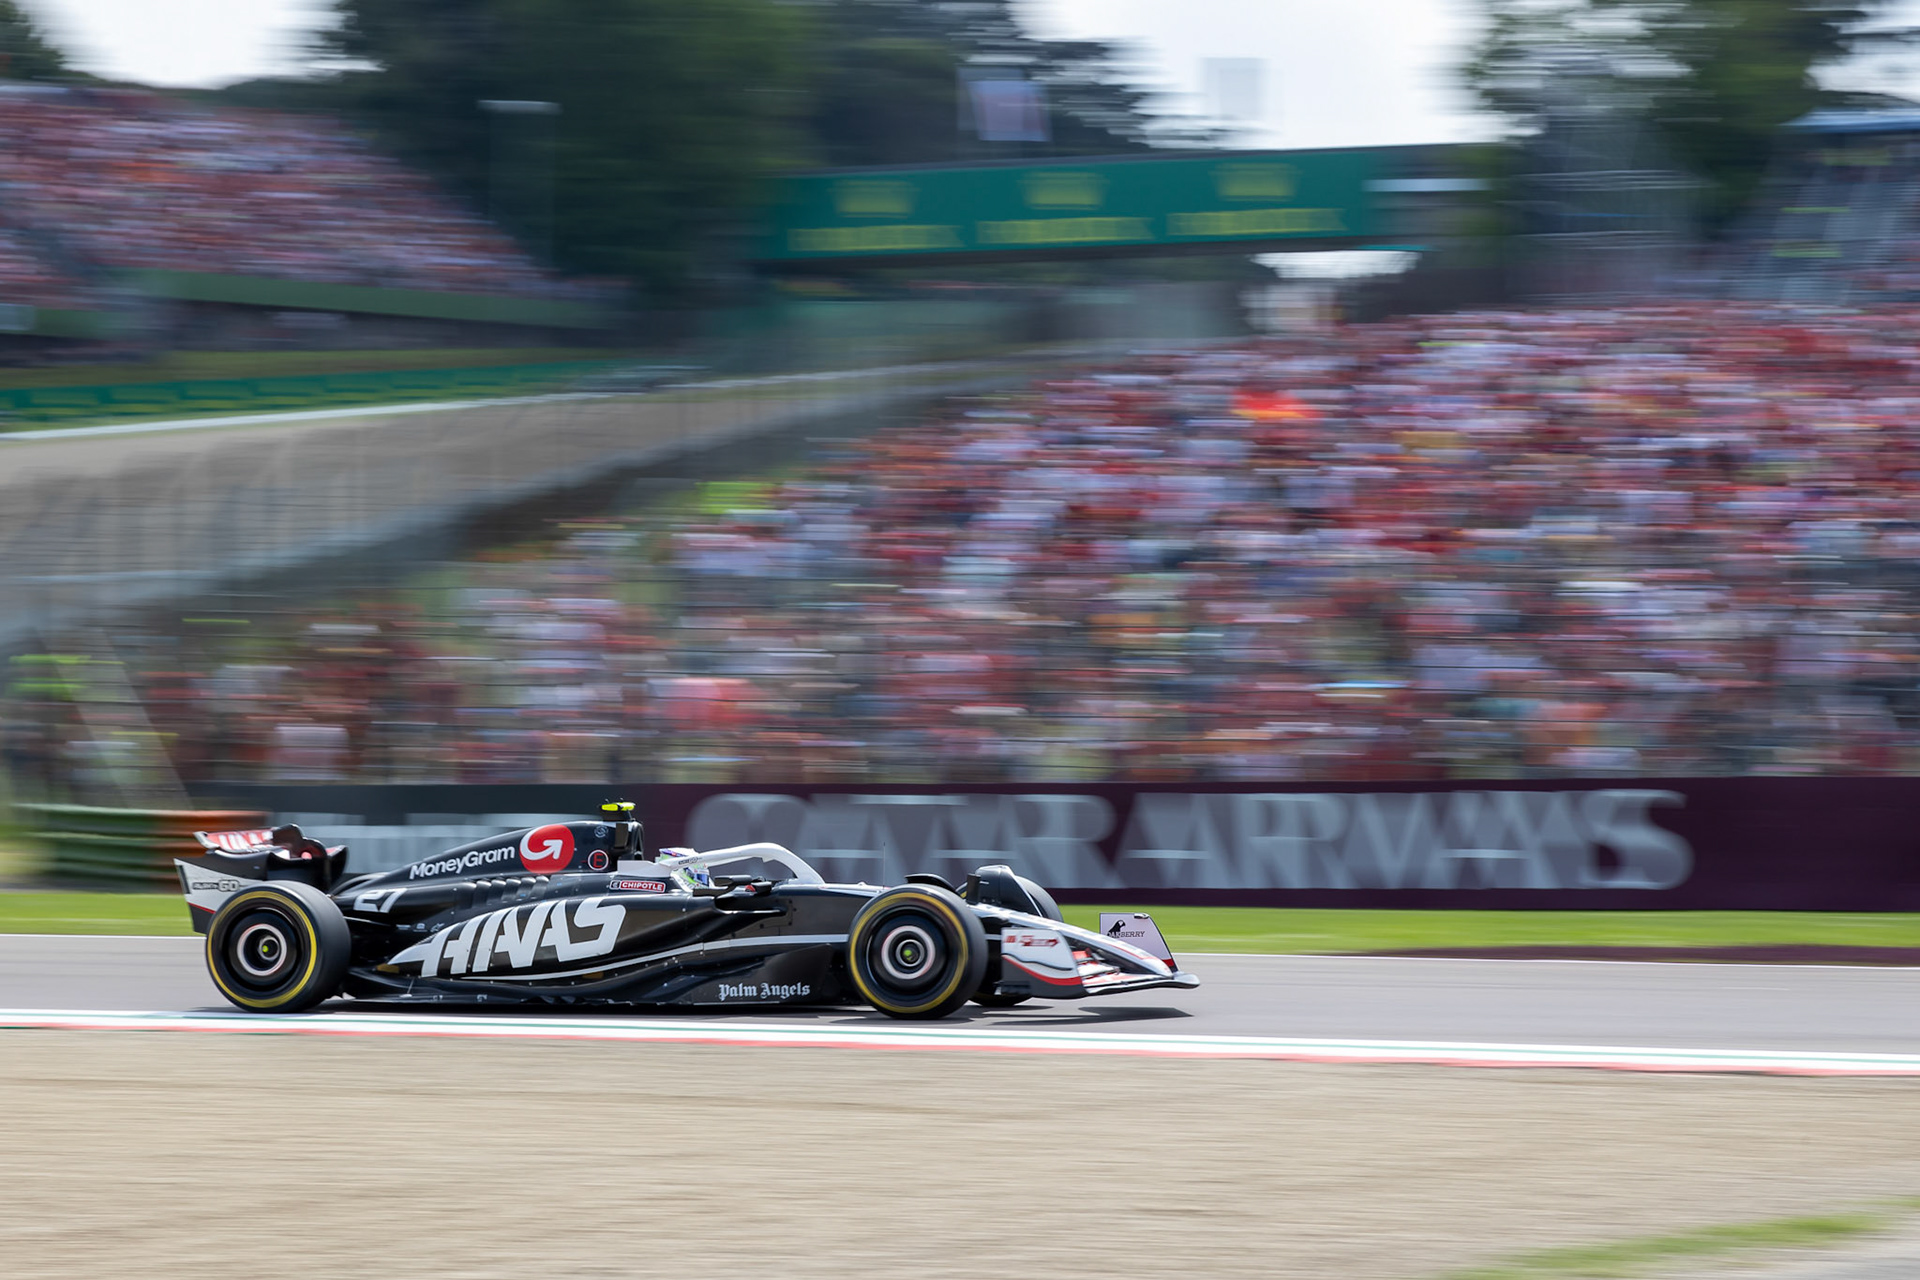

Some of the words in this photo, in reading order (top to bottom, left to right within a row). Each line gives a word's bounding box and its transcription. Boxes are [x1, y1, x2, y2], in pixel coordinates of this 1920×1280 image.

[409, 846, 515, 880] MoneyGram
[622, 882, 663, 891] CHIPOTLE
[353, 887, 408, 913] 27
[387, 897, 627, 978] HAAS
[718, 983, 757, 1001] Palm
[760, 982, 810, 999] Angels
